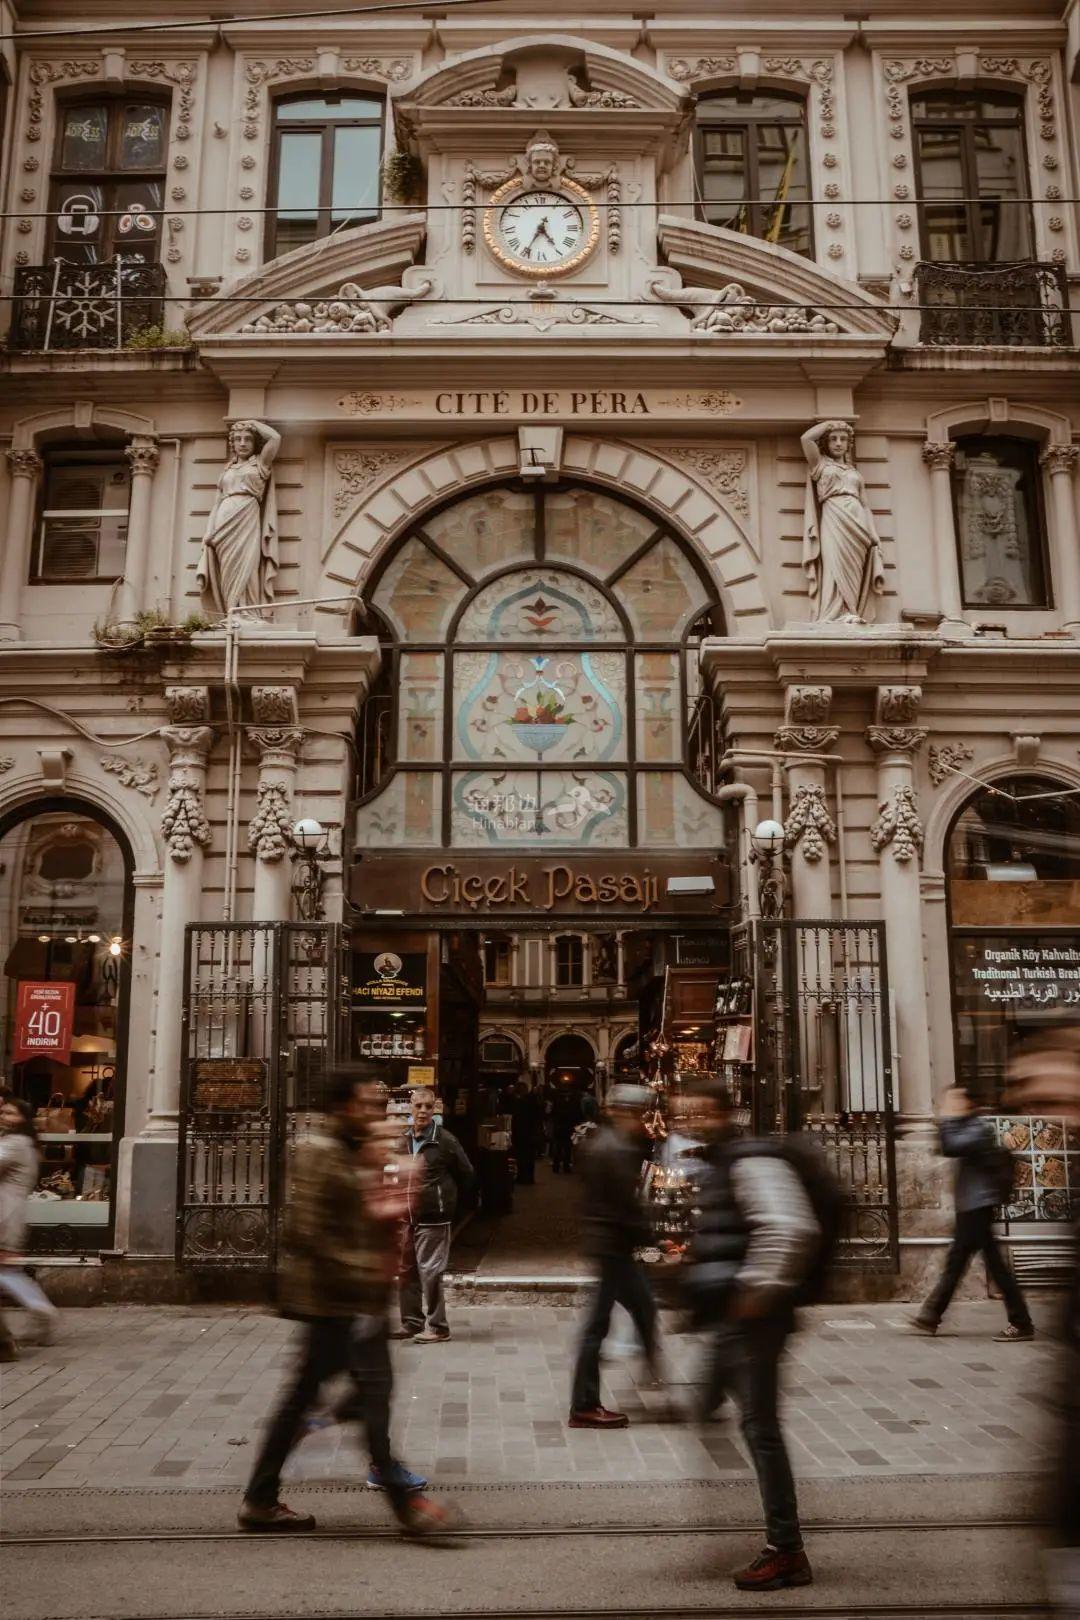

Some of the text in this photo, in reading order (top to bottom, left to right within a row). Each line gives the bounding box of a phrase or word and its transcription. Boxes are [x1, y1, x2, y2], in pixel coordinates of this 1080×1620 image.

[435, 390, 650, 414] CITÉ DE PÉRA
[984, 947, 1021, 963] Organik
[1022, 948, 1041, 963] Köy
[971, 966, 1021, 979] Traditional
[1022, 966, 1057, 979] Turkish
[28, 1011, 61, 1036] 40
